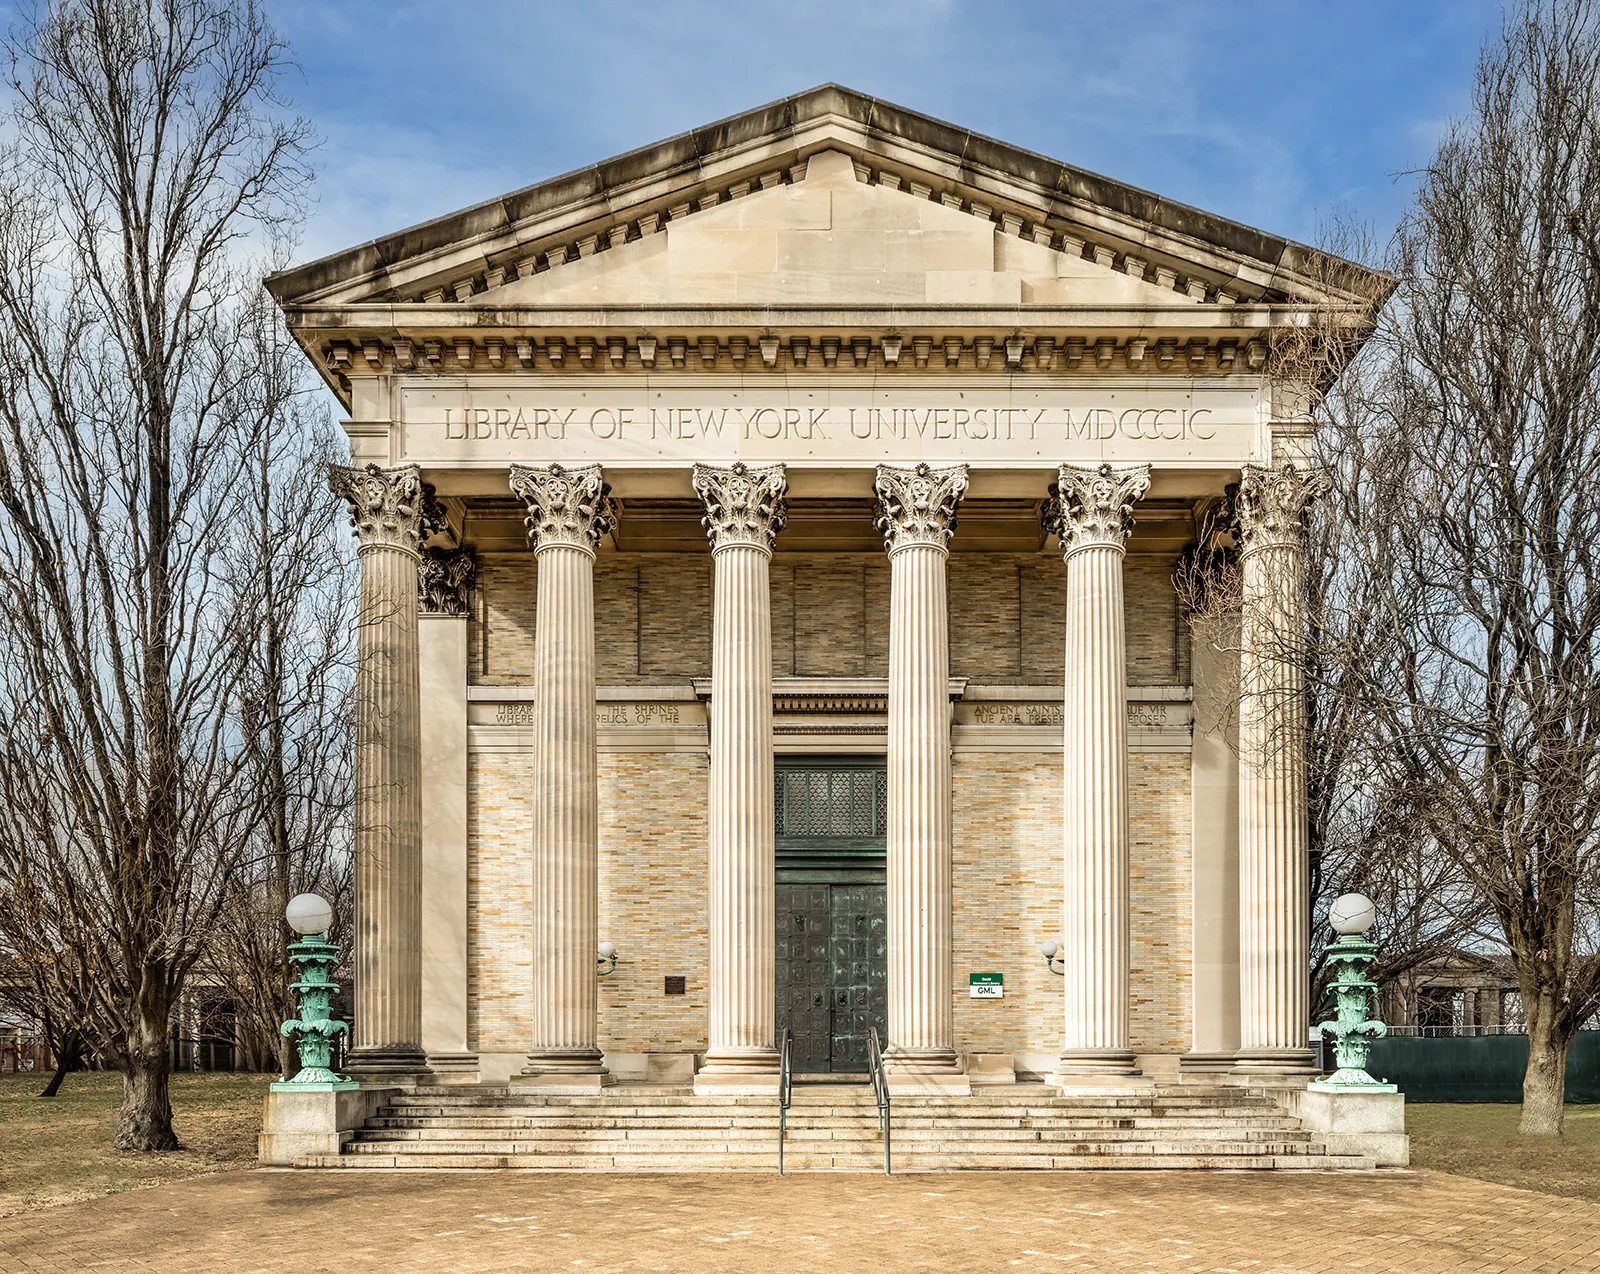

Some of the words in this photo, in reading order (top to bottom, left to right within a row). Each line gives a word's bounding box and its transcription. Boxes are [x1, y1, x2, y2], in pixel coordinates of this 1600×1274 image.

[444, 407, 577, 440] LIBRARY
[589, 407, 635, 440] OF
[650, 407, 730, 440] NEW
[734, 407, 832, 440] YORK
[848, 407, 1048, 440] UNIVERSITY
[1062, 408, 1217, 441] MDCCCIC
[606, 704, 627, 715] THE
[634, 704, 680, 715] SHRINES
[974, 705, 1021, 715] ANCIENT
[1025, 705, 1061, 715] SAINTS
[1149, 705, 1168, 715] VIR
[495, 714, 534, 724] WHERE
[636, 714, 652, 724] OF
[658, 714, 680, 724] THE
[974, 714, 995, 724] TUE
[1000, 714, 1021, 724] ARE
[977, 986, 996, 994] GML
